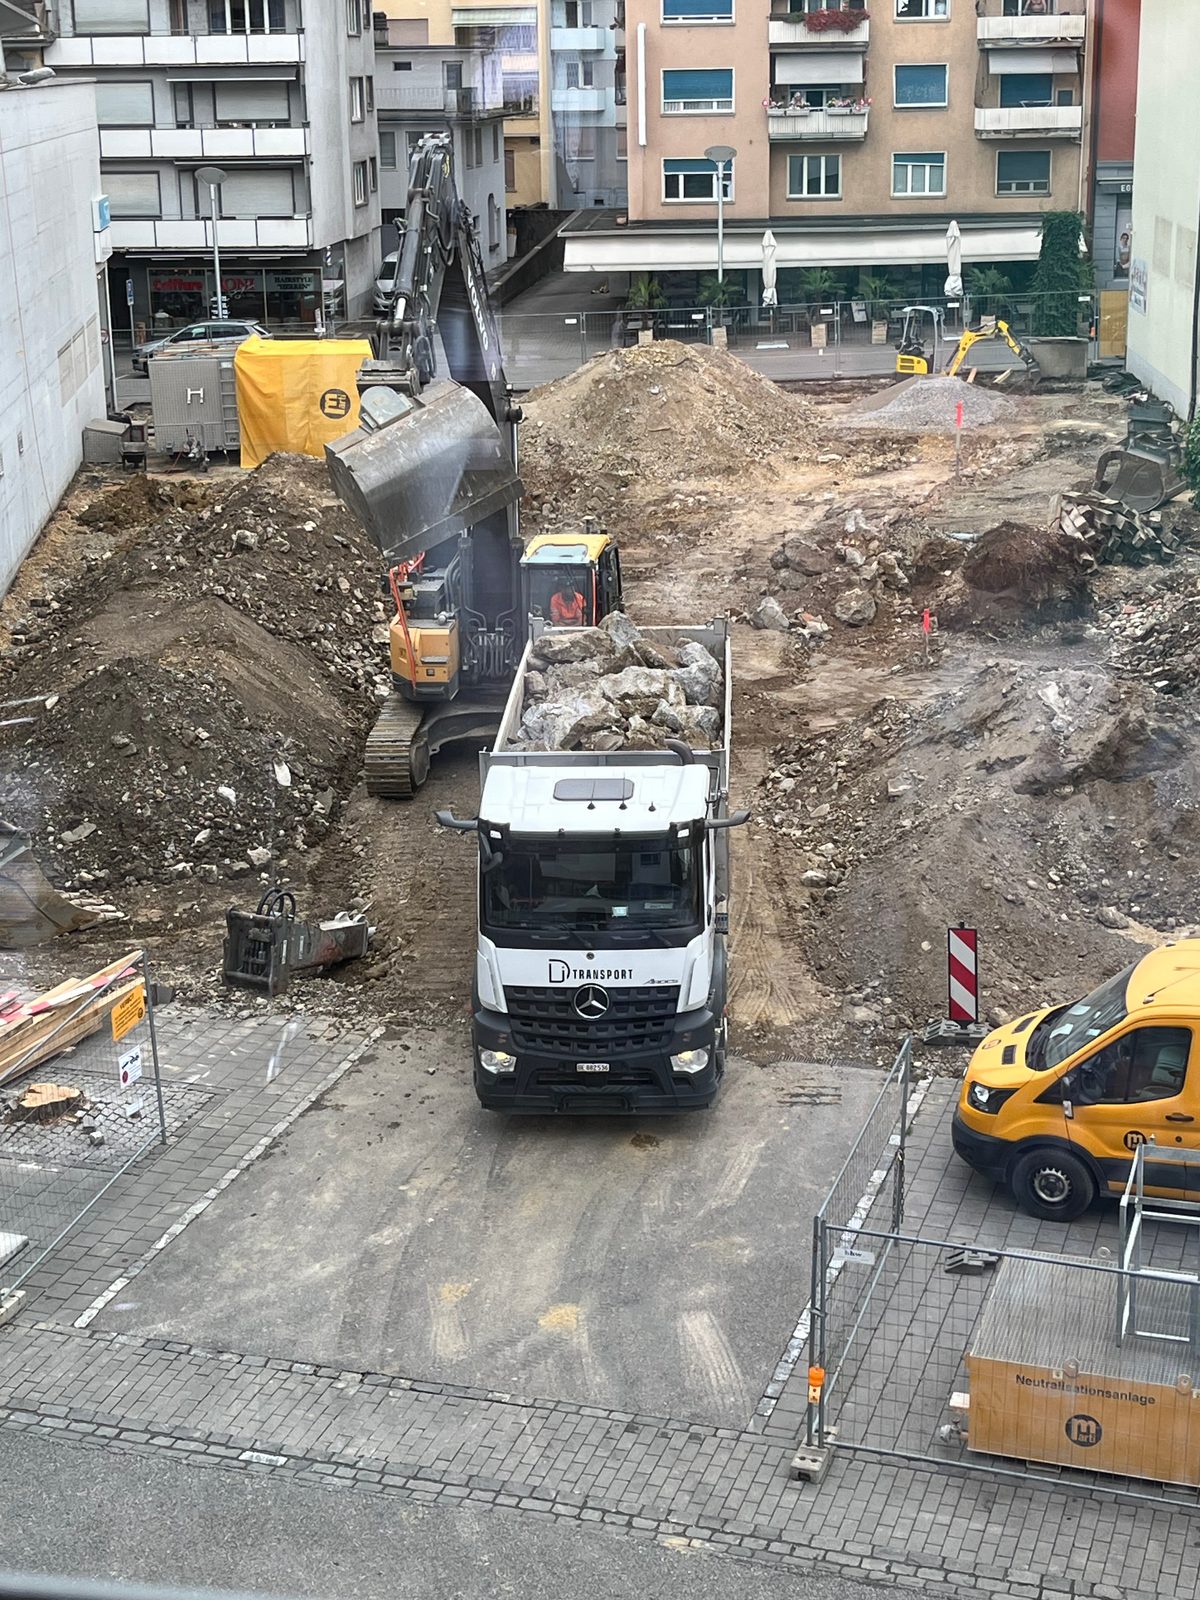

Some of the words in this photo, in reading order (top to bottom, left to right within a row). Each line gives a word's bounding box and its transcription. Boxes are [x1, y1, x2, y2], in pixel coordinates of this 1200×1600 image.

[467, 264, 489, 351] VOLVO
[572, 969, 633, 979] TRANSPORT
[1015, 1373, 1156, 1406] Neutralisationsanlage
